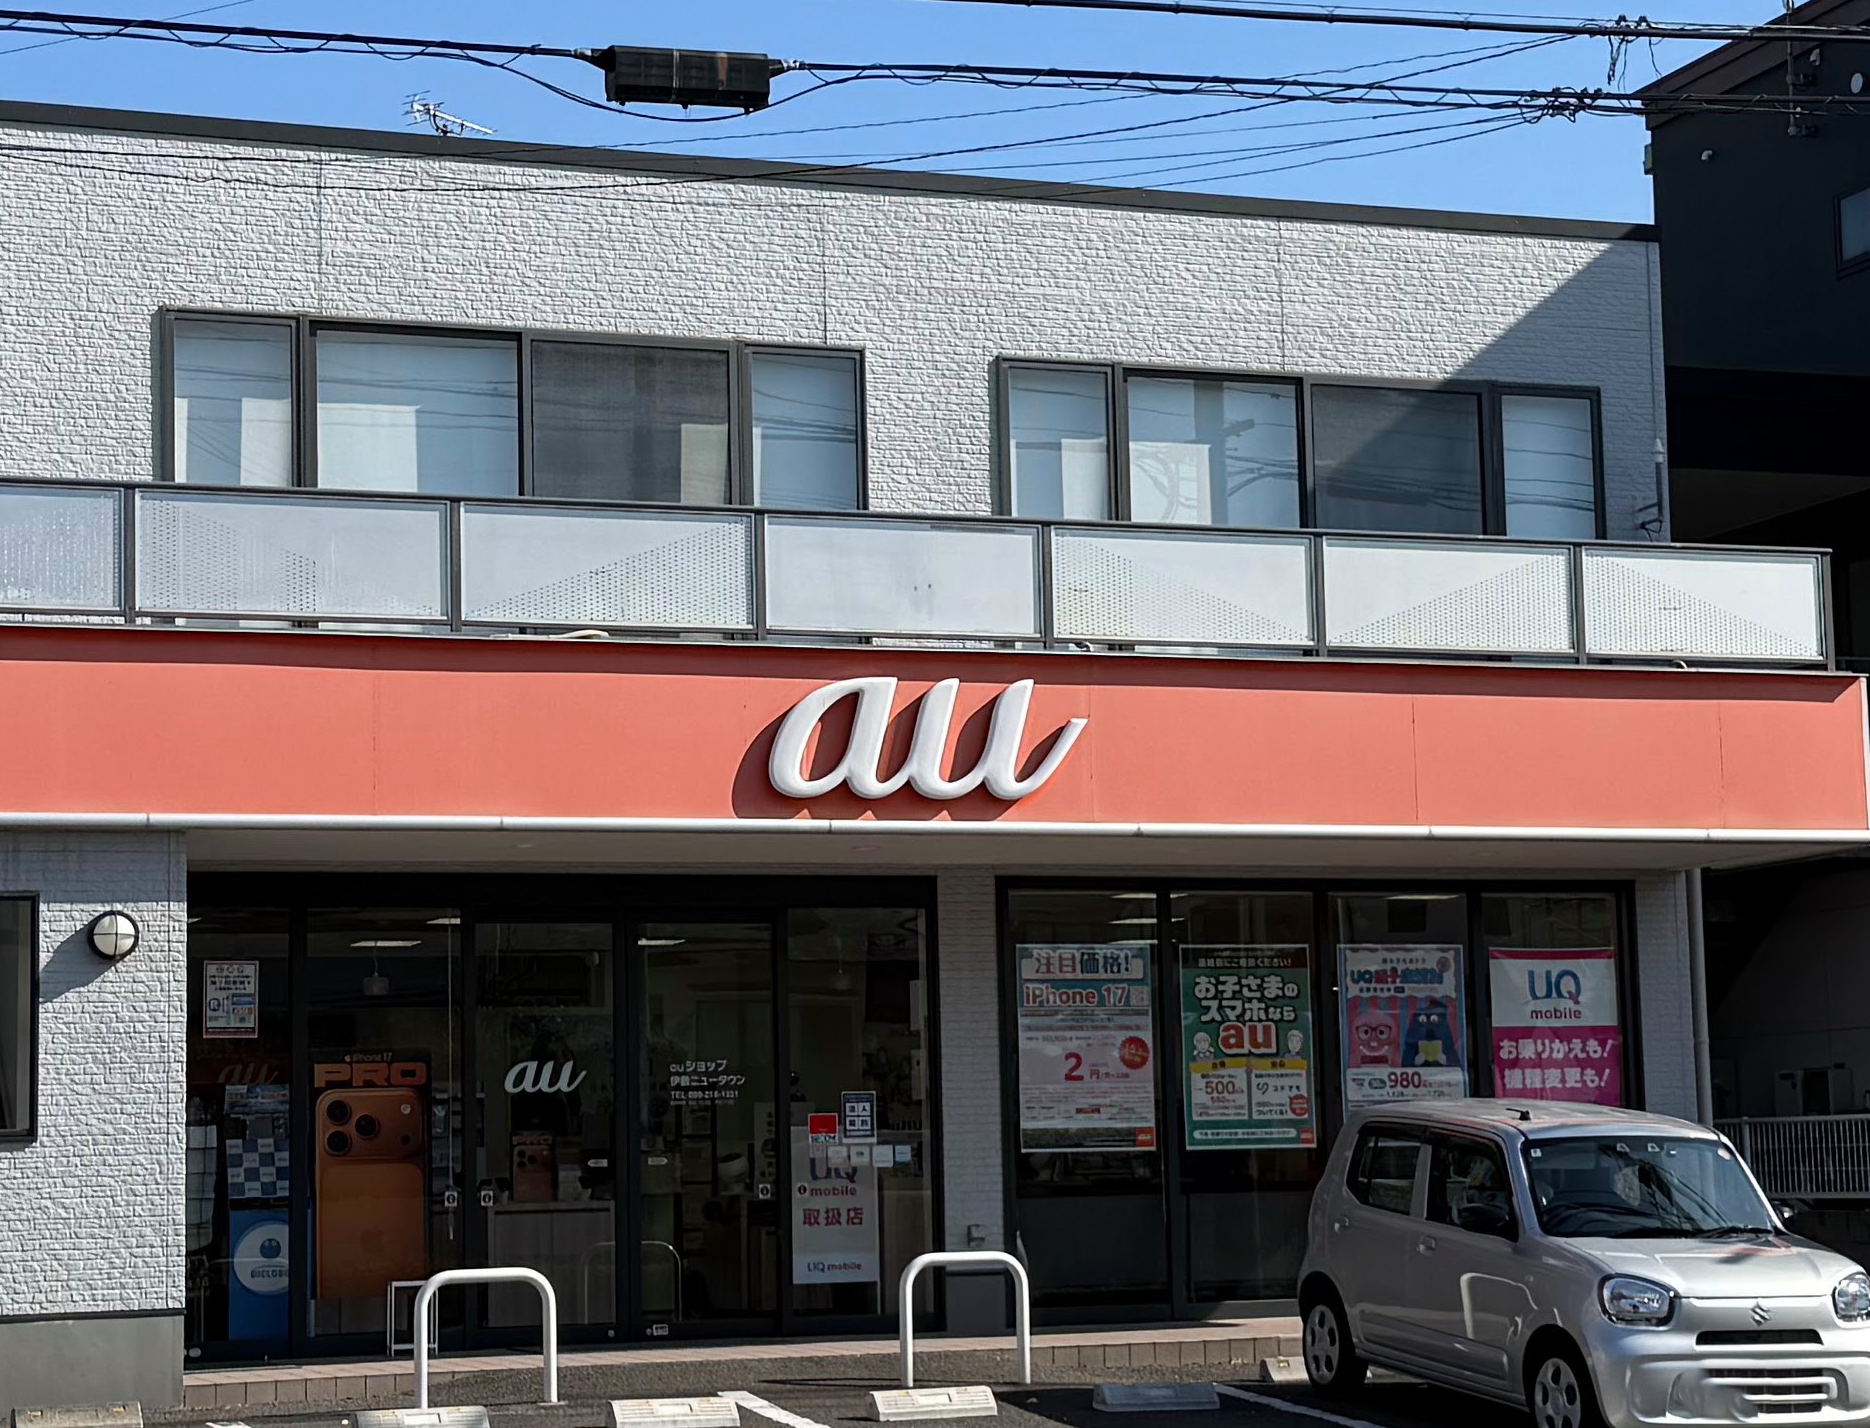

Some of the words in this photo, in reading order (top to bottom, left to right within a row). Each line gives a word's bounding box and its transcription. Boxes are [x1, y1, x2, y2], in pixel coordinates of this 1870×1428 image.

[768, 676, 1089, 800] au
[1025, 985, 1096, 1005] iPhone
[1103, 985, 1127, 1005] 17
[1194, 975, 1299, 999] お子さまの
[1528, 969, 1581, 1004] UQ
[1200, 999, 1295, 1021] スマホなら
[1531, 1008, 1581, 1019] mobile
[1219, 1022, 1275, 1051] au
[314, 1062, 428, 1088] PRO
[504, 1060, 587, 1093] au
[1064, 1052, 1084, 1081] 2
[1388, 1071, 1422, 1089] 980
[810, 1185, 857, 1196] mobile
[802, 1207, 864, 1227] 取扱店
